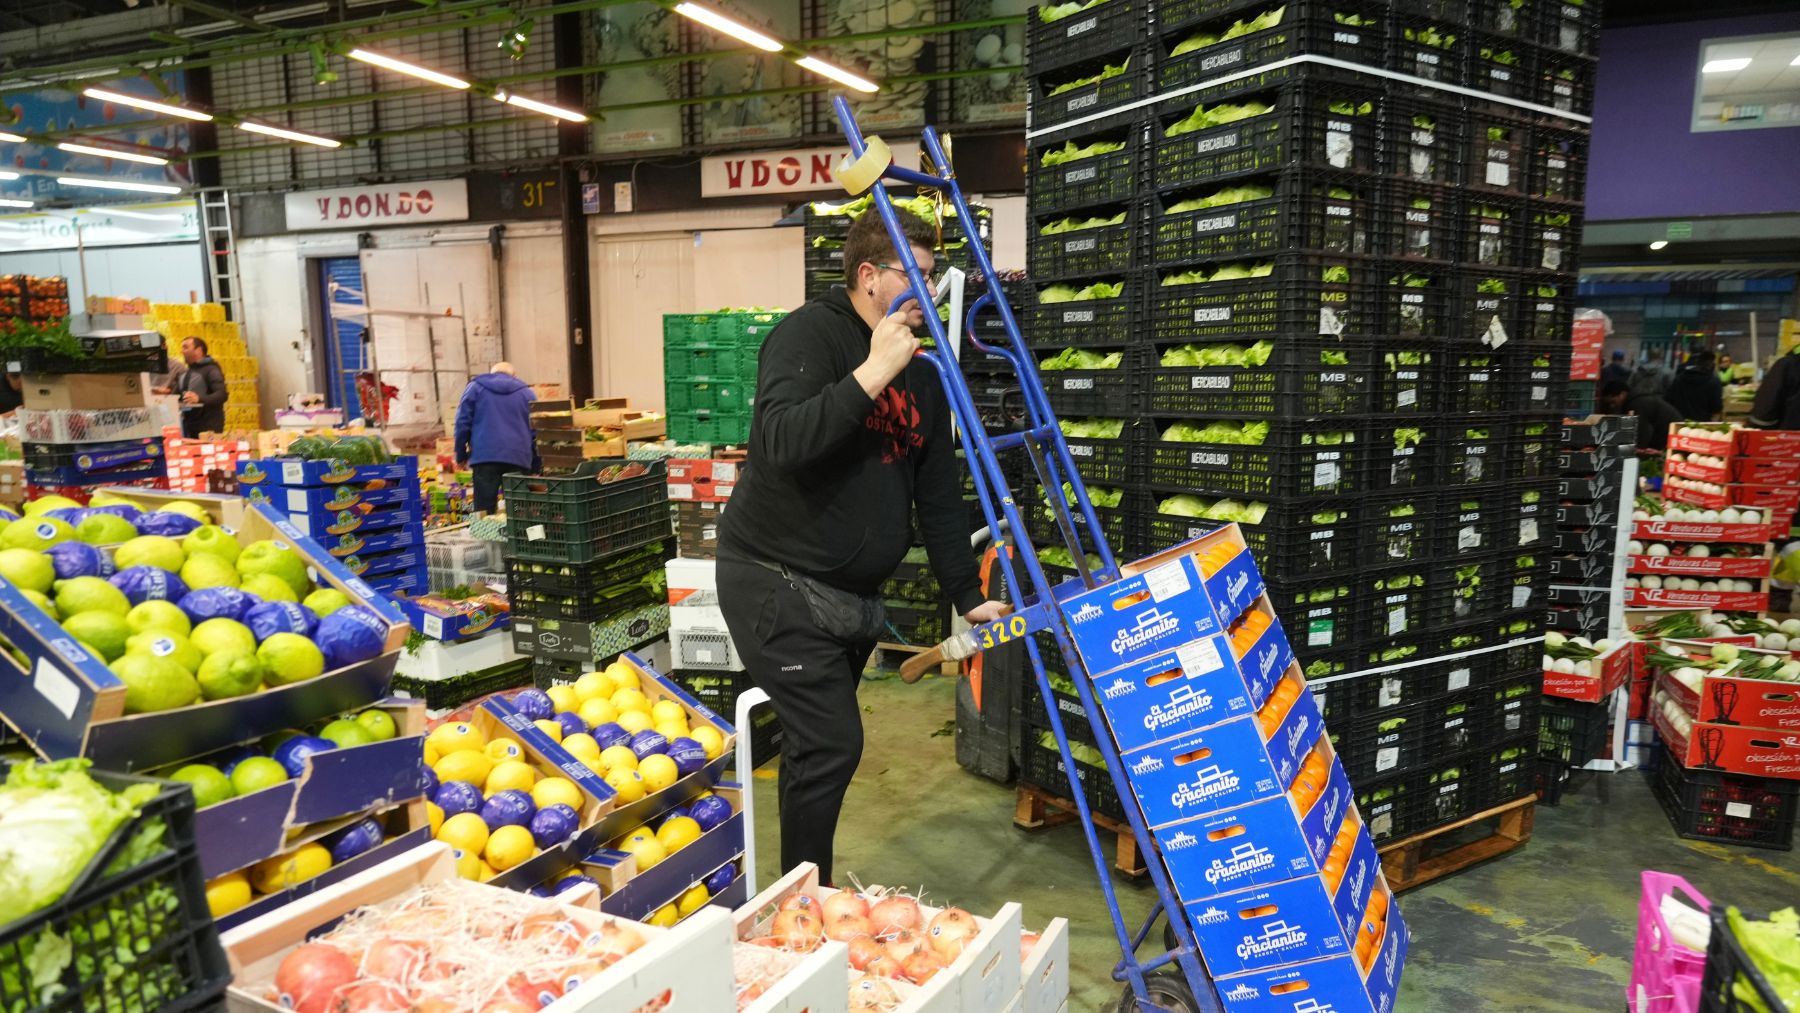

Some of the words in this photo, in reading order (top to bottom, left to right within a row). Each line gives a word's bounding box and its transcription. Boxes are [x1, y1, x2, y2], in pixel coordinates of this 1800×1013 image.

[1067, 17, 1097, 38] MERCABILBAO
[1334, 32, 1360, 45] MB
[1201, 49, 1241, 71] MERCABILBAO
[1416, 52, 1440, 65] MB
[1490, 69, 1511, 81] MB
[1554, 84, 1573, 96] MB
[1067, 92, 1098, 112] MERCABILBAO
[1327, 120, 1352, 132] MB
[1198, 134, 1237, 153] MERCABILBAO
[1488, 147, 1509, 160] MB
[1548, 159, 1567, 169] MB
[1065, 167, 1096, 184] MERCABILBAO
[1327, 206, 1351, 216] MB
[1406, 211, 1430, 222] MB
[1197, 215, 1236, 233] MERCABILBAO
[1480, 224, 1500, 234] MB
[1543, 231, 1561, 241] MB
[1065, 238, 1096, 253] MERCABILBAO
[1321, 292, 1347, 302] MB
[1402, 294, 1424, 303] MB
[1536, 303, 1554, 311] MB
[1063, 311, 1094, 323] MERCABILBAO
[1194, 307, 1231, 322] MERCABILBAO
[1320, 372, 1346, 382] MB
[1397, 371, 1419, 380] MB
[1469, 373, 1489, 382] MB
[1531, 371, 1550, 379] MB
[1063, 378, 1094, 390] MERCABILBAO
[1191, 376, 1230, 390] MERCABILBAO
[1393, 447, 1414, 456] MB
[1466, 446, 1487, 455] MB
[1191, 453, 1229, 466] MERCABILBAO
[1317, 452, 1341, 461] MB
[1520, 504, 1538, 513] MB
[1460, 513, 1479, 523] MB
[1390, 523, 1413, 532] MB
[1310, 530, 1334, 540] MB
[1386, 594, 1408, 603] MB
[1308, 608, 1332, 618] MB
[979, 616, 1026, 648] 320
[1111, 616, 1180, 656] Gracianito
[1117, 628, 1129, 640] El
[1150, 703, 1162, 715] El
[1504, 701, 1521, 710] MB
[1143, 694, 1213, 731] Gracianito
[1444, 718, 1464, 728] MB
[1377, 734, 1399, 745] MB
[1499, 763, 1518, 773] MB
[1171, 775, 1240, 809] Gracianito
[1177, 783, 1189, 794] El
[1439, 784, 1458, 794] MB
[1372, 803, 1393, 815] MB
[1205, 852, 1275, 884] Gracianito
[1212, 859, 1223, 870] El
[1236, 930, 1307, 960] Gracianito
[1243, 935, 1254, 945] El
